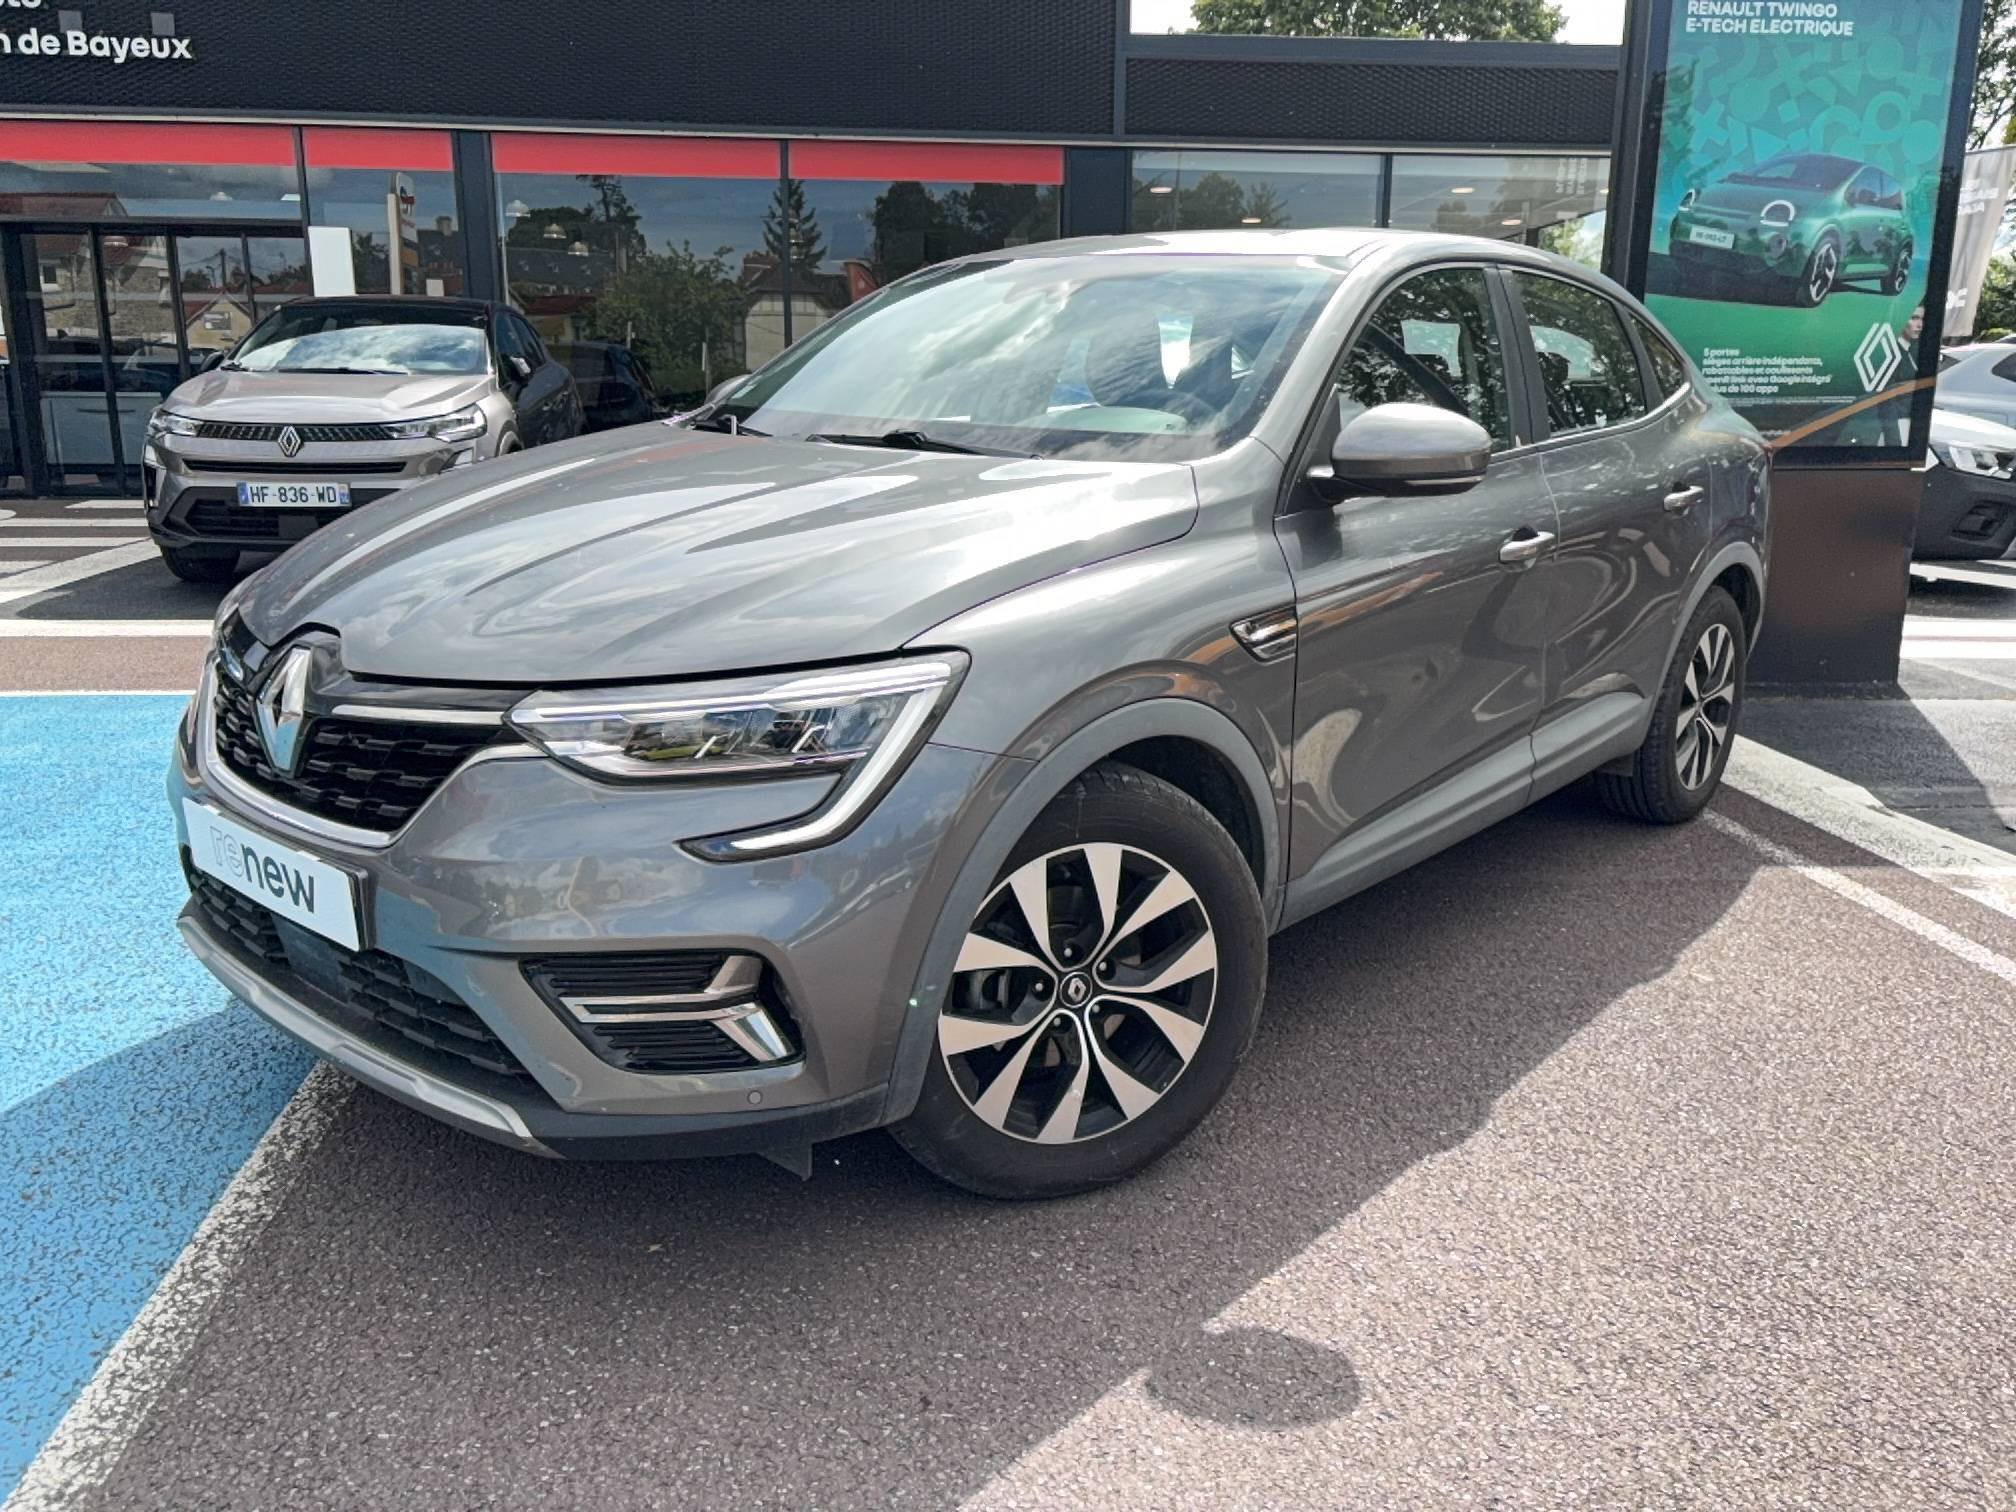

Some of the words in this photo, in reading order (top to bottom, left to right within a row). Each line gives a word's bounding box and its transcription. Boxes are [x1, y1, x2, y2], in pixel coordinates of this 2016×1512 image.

[1687, 1, 1765, 17] RENAULT
[1767, 2, 1838, 18] TWINGO
[1686, 17, 1747, 33] E-TECH
[1750, 19, 1854, 37] ELECTRIQUE
[18, 27, 61, 55] de
[66, 30, 192, 63] Bayeux
[249, 486, 337, 503] HF-836-WD
[210, 826, 315, 914] renew
